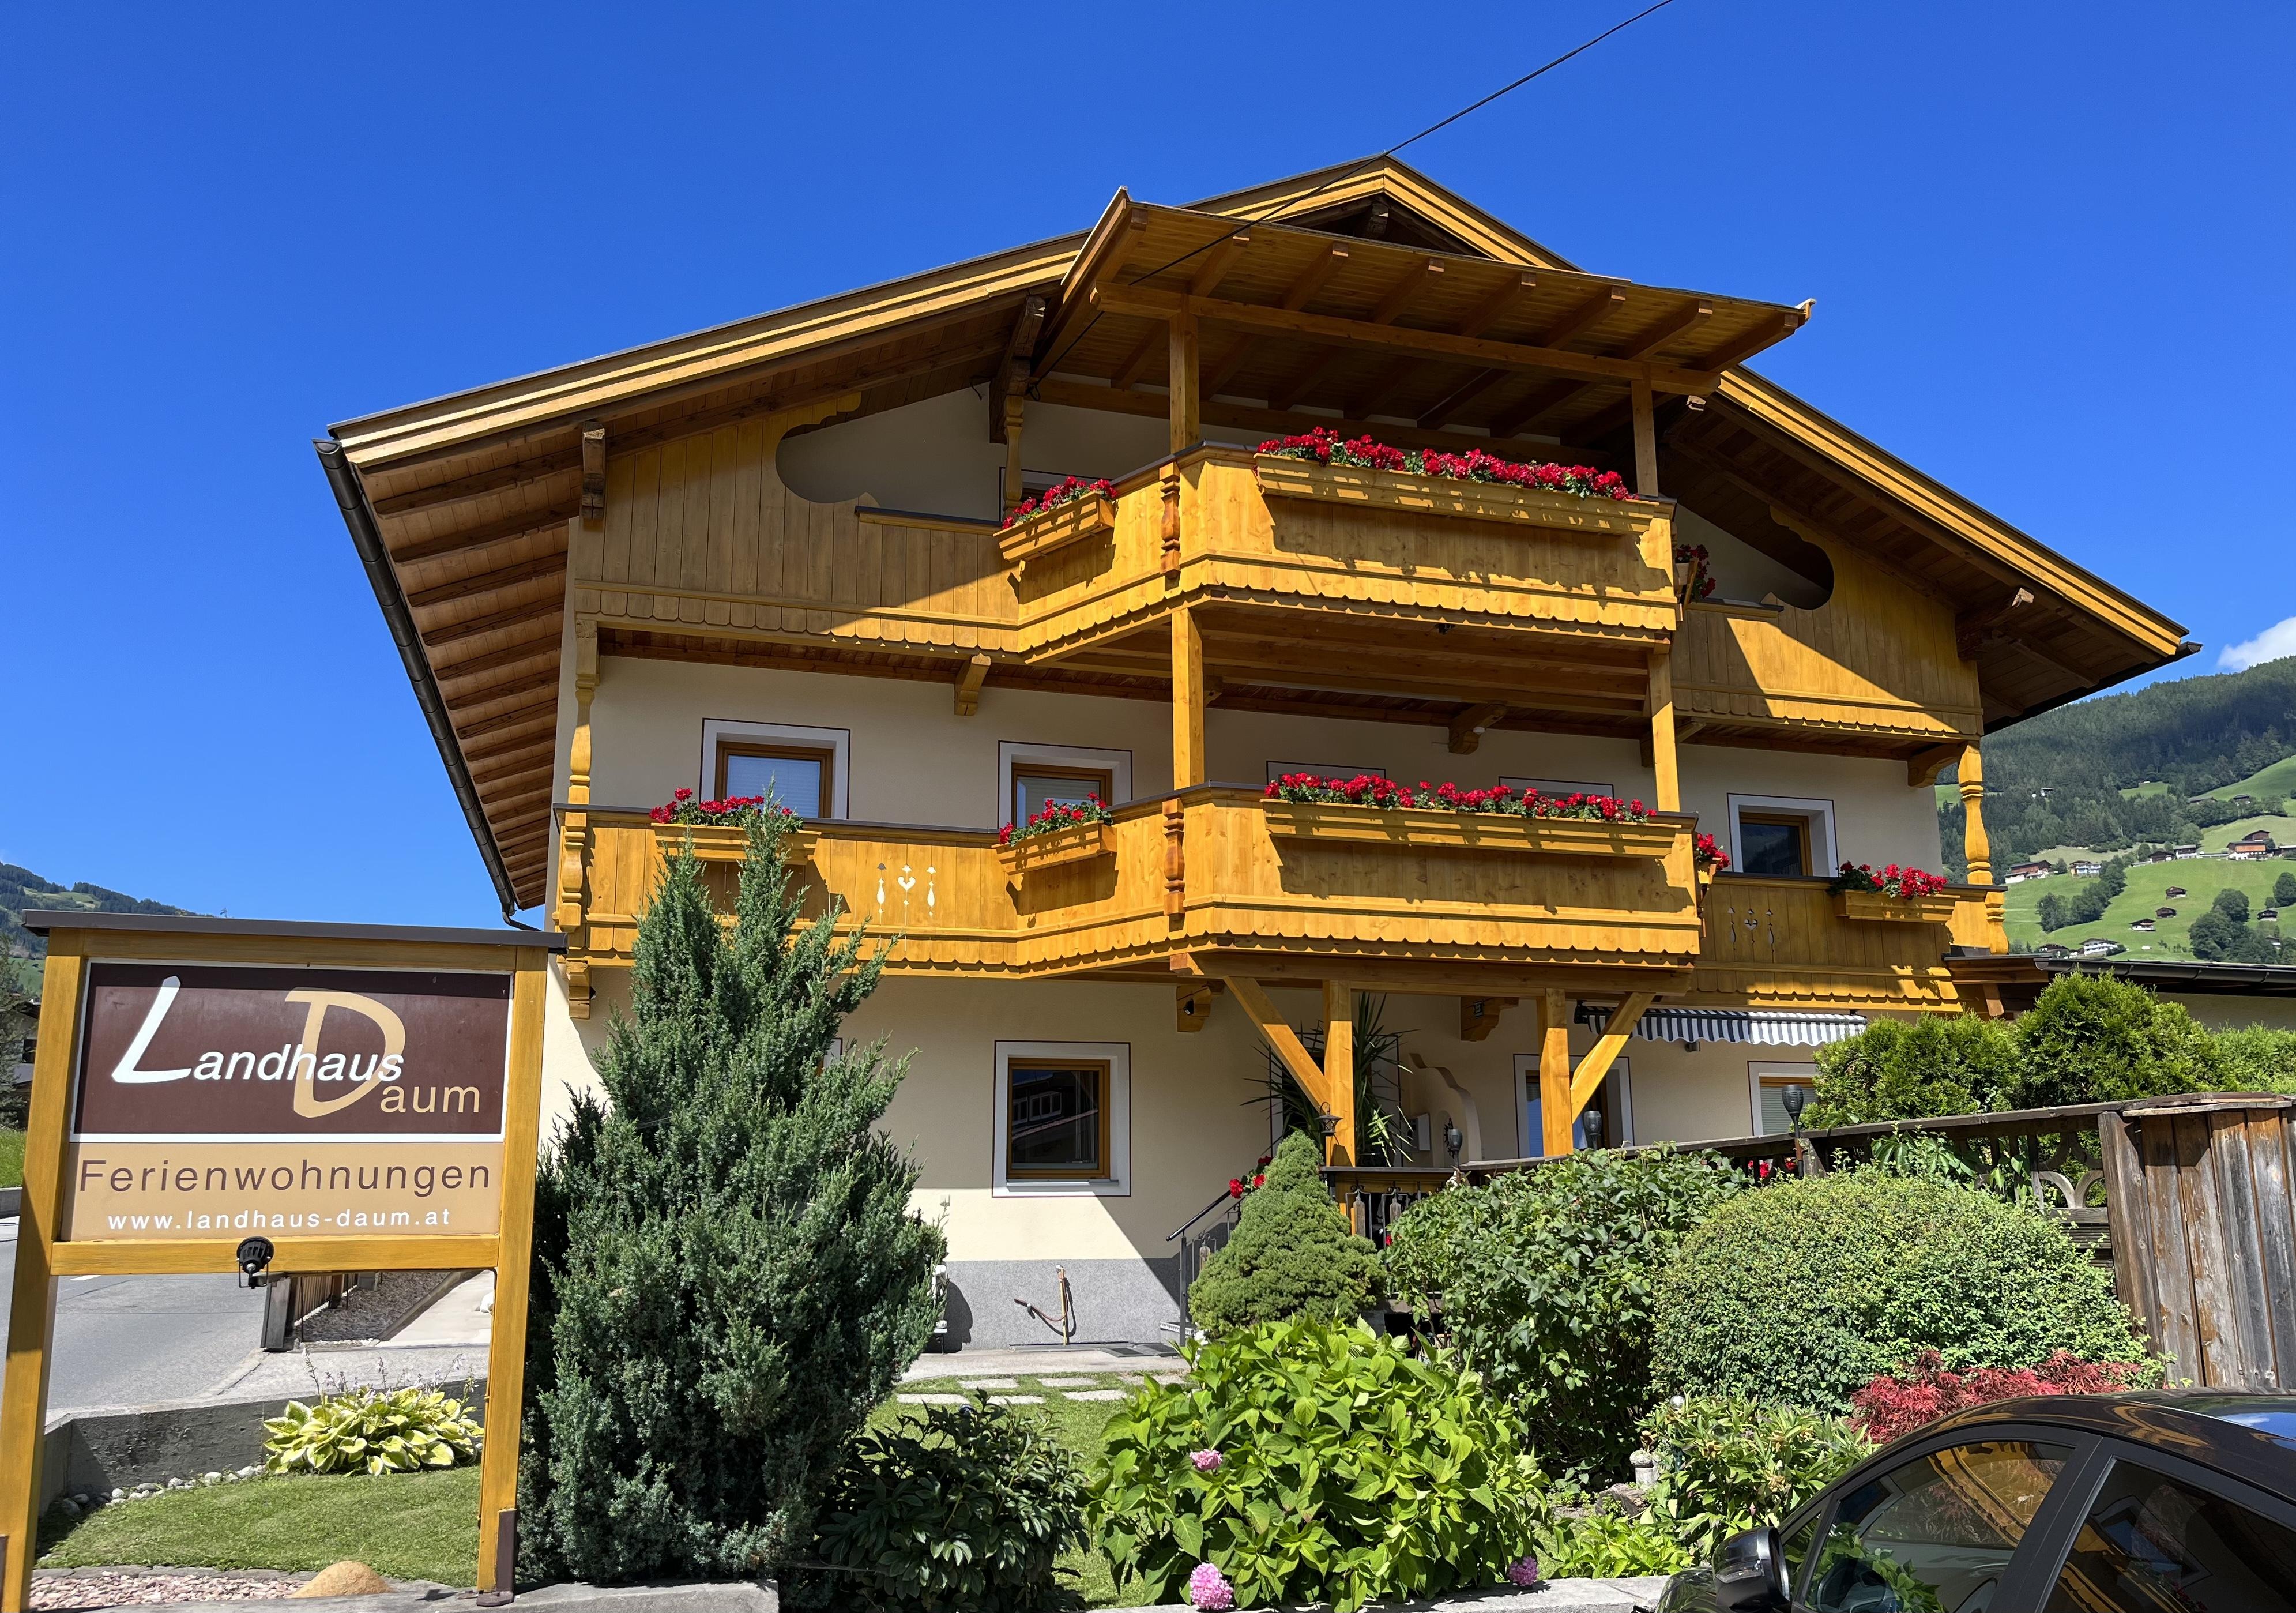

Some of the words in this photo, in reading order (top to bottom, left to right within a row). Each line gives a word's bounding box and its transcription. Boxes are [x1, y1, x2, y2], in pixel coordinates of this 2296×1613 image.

[111, 975, 404, 1084] Landhaus
[284, 987, 480, 1118] Daum
[80, 1159, 490, 1197] Ferienwohnungen
[107, 1208, 451, 1230] www.landhaus-daum.at
